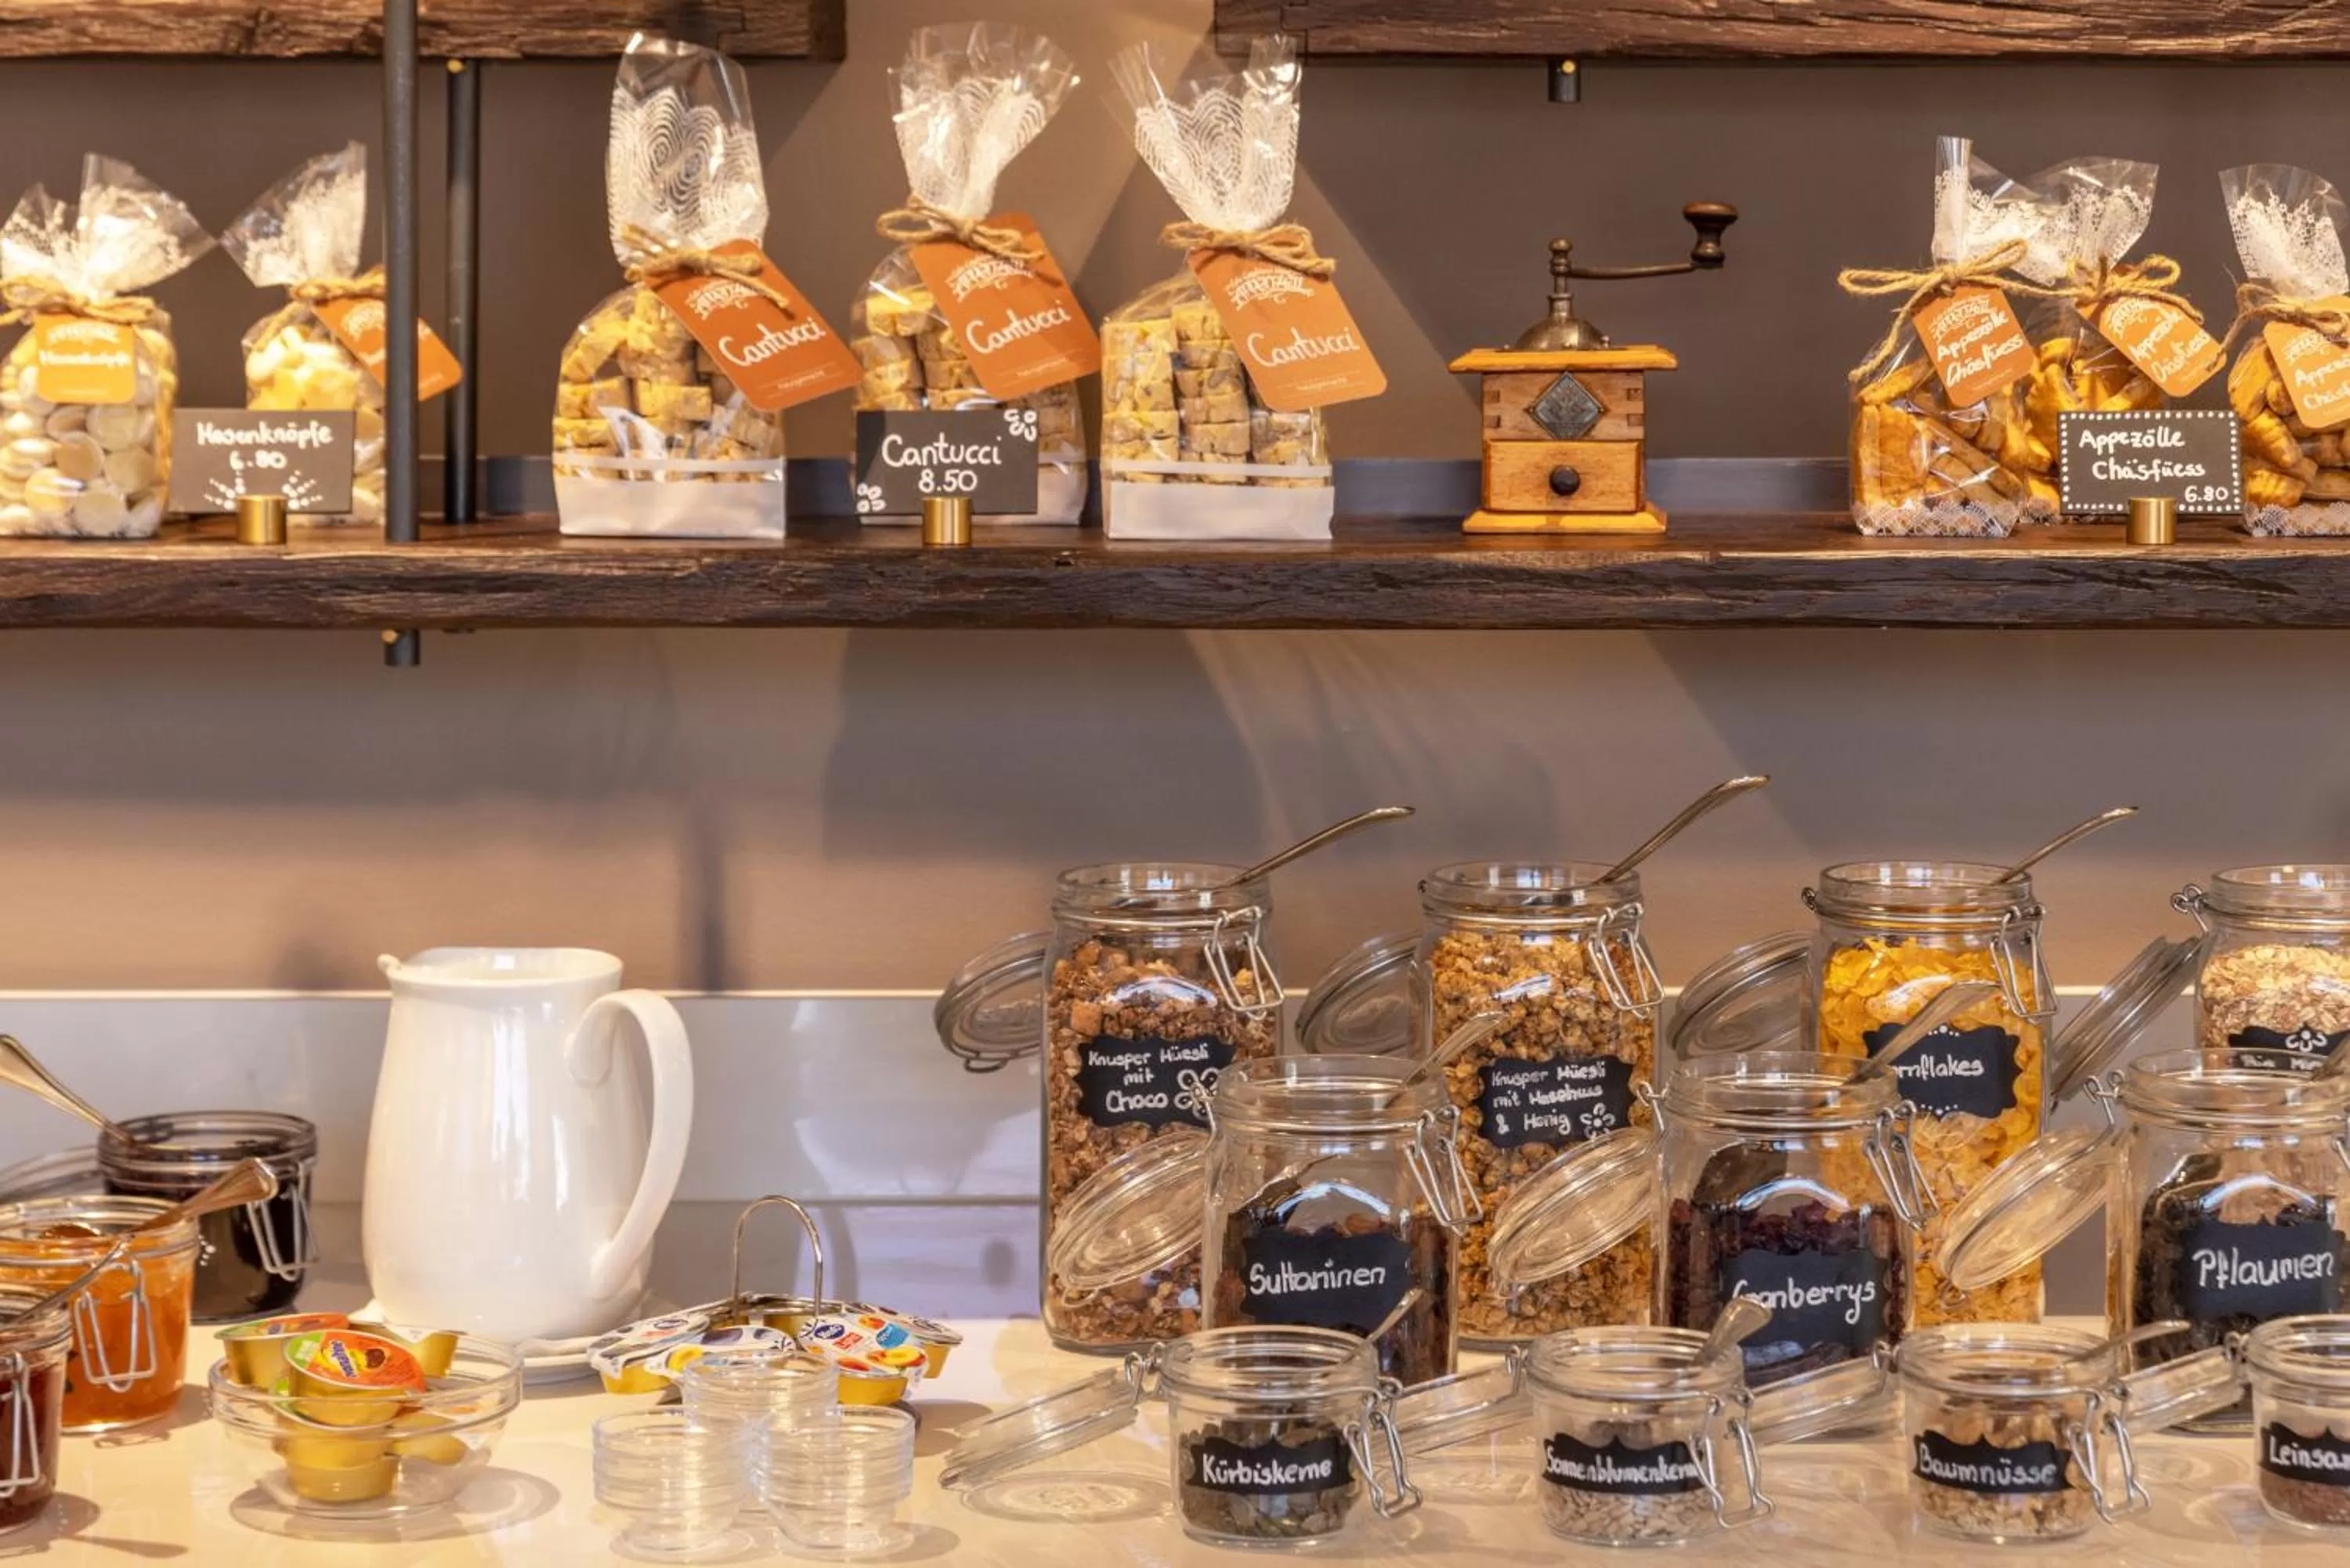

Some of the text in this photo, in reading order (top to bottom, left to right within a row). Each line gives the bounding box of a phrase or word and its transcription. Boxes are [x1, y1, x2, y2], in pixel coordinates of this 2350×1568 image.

[718, 316, 826, 367] Cantucci
[966, 300, 1072, 354] Cantucci
[1246, 326, 1361, 367] Cantucci
[197, 419, 334, 450] Hasenknöpfe
[2079, 426, 2186, 455] Appezölle
[229, 450, 287, 470] 6.80
[882, 432, 1003, 468] Cantucci
[918, 468, 978, 493] 8.50
[2092, 457, 2206, 483] Chäsfüess
[2185, 485, 2229, 504] 6.80
[1088, 1050, 1152, 1071] Knusper
[1892, 1053, 1985, 1082] rnflakes
[1123, 1067, 1155, 1086] mit
[1491, 1071, 1549, 1090] Knusper
[1105, 1089, 1168, 1113] Choco
[1492, 1089, 1521, 1108] mit
[1495, 1108, 1571, 1136] & Honig
[1249, 1258, 1386, 1295] Sultaninen
[2192, 1246, 2334, 1289] Pflaumen
[1732, 1276, 1876, 1325] Canberrys
[1202, 1453, 1333, 1486] Kürbiskerne
[1919, 1442, 2057, 1486] Baumnüsse
